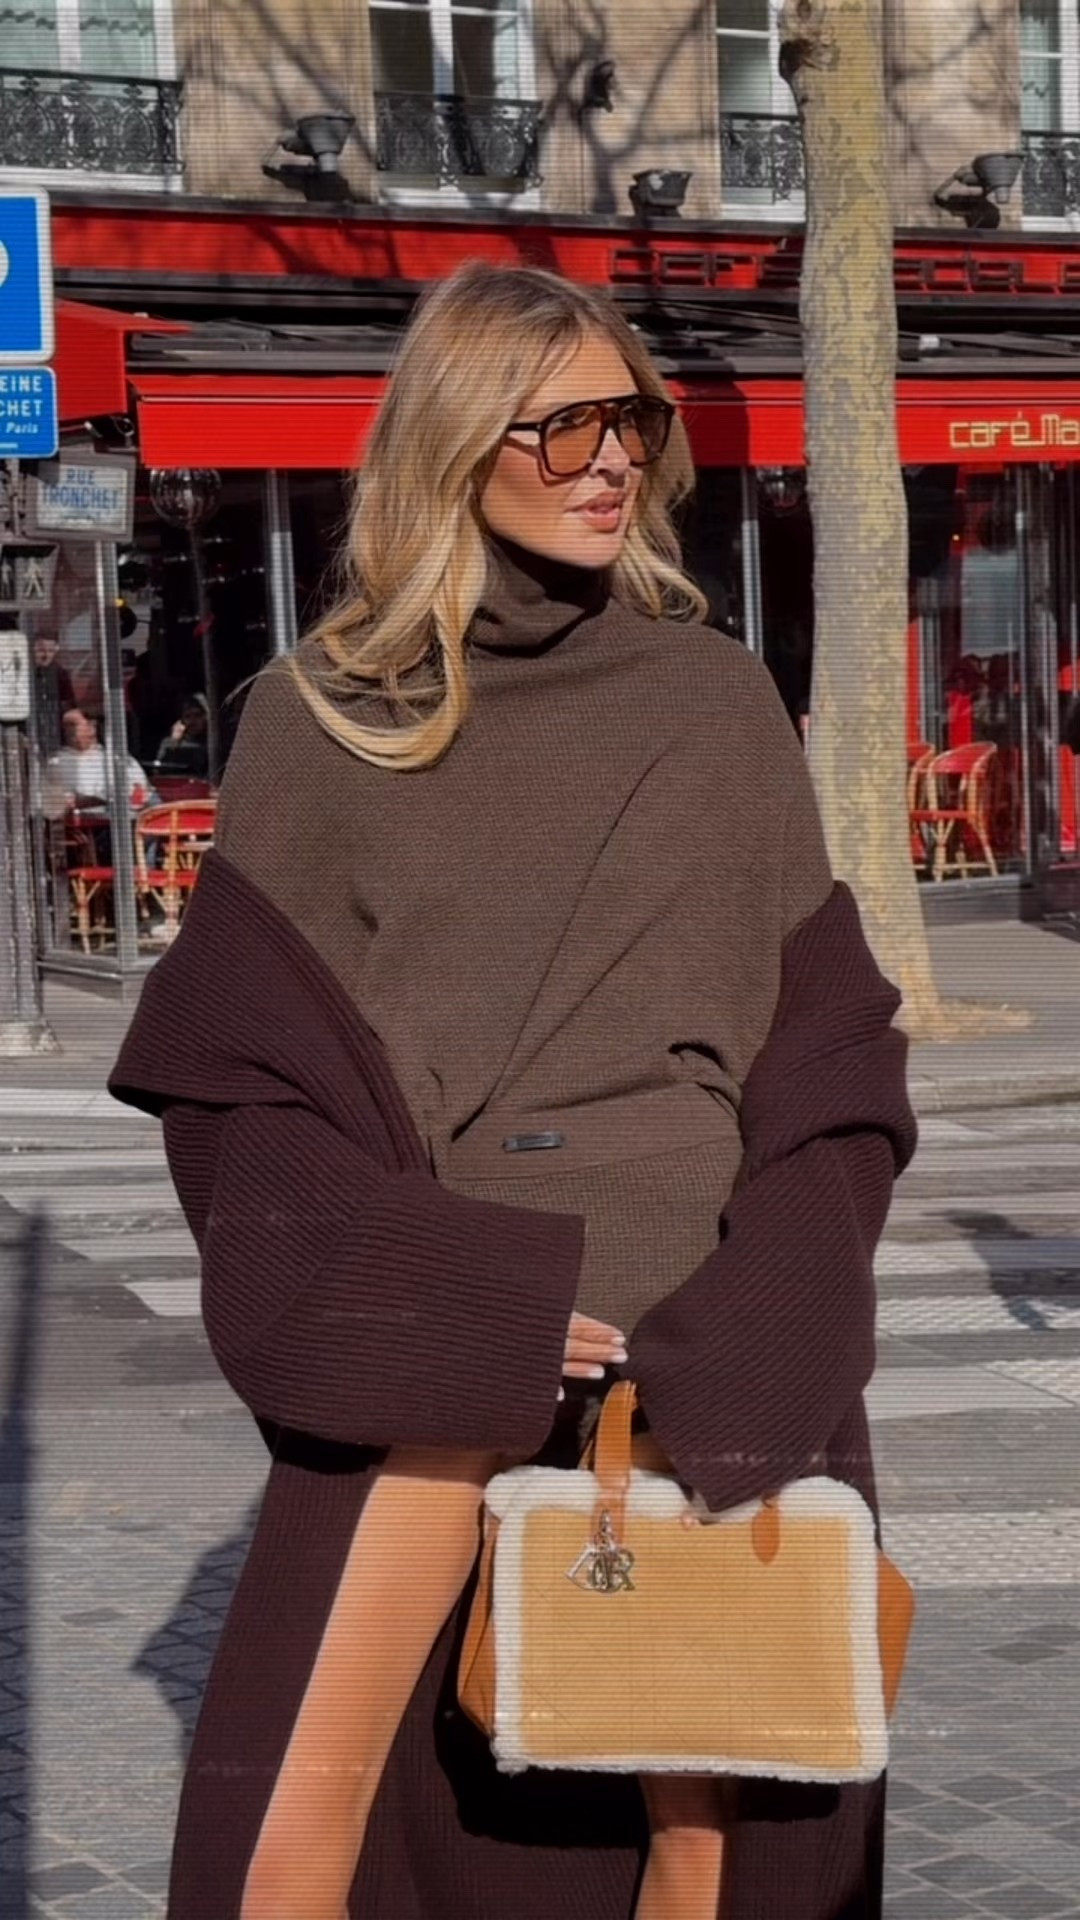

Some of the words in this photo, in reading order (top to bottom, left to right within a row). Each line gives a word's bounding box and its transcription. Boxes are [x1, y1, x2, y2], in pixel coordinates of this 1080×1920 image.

[0, 375, 43, 392] EINE
[6, 422, 39, 434] Paris
[949, 411, 1038, 448] café
[66, 468, 95, 485] RUE
